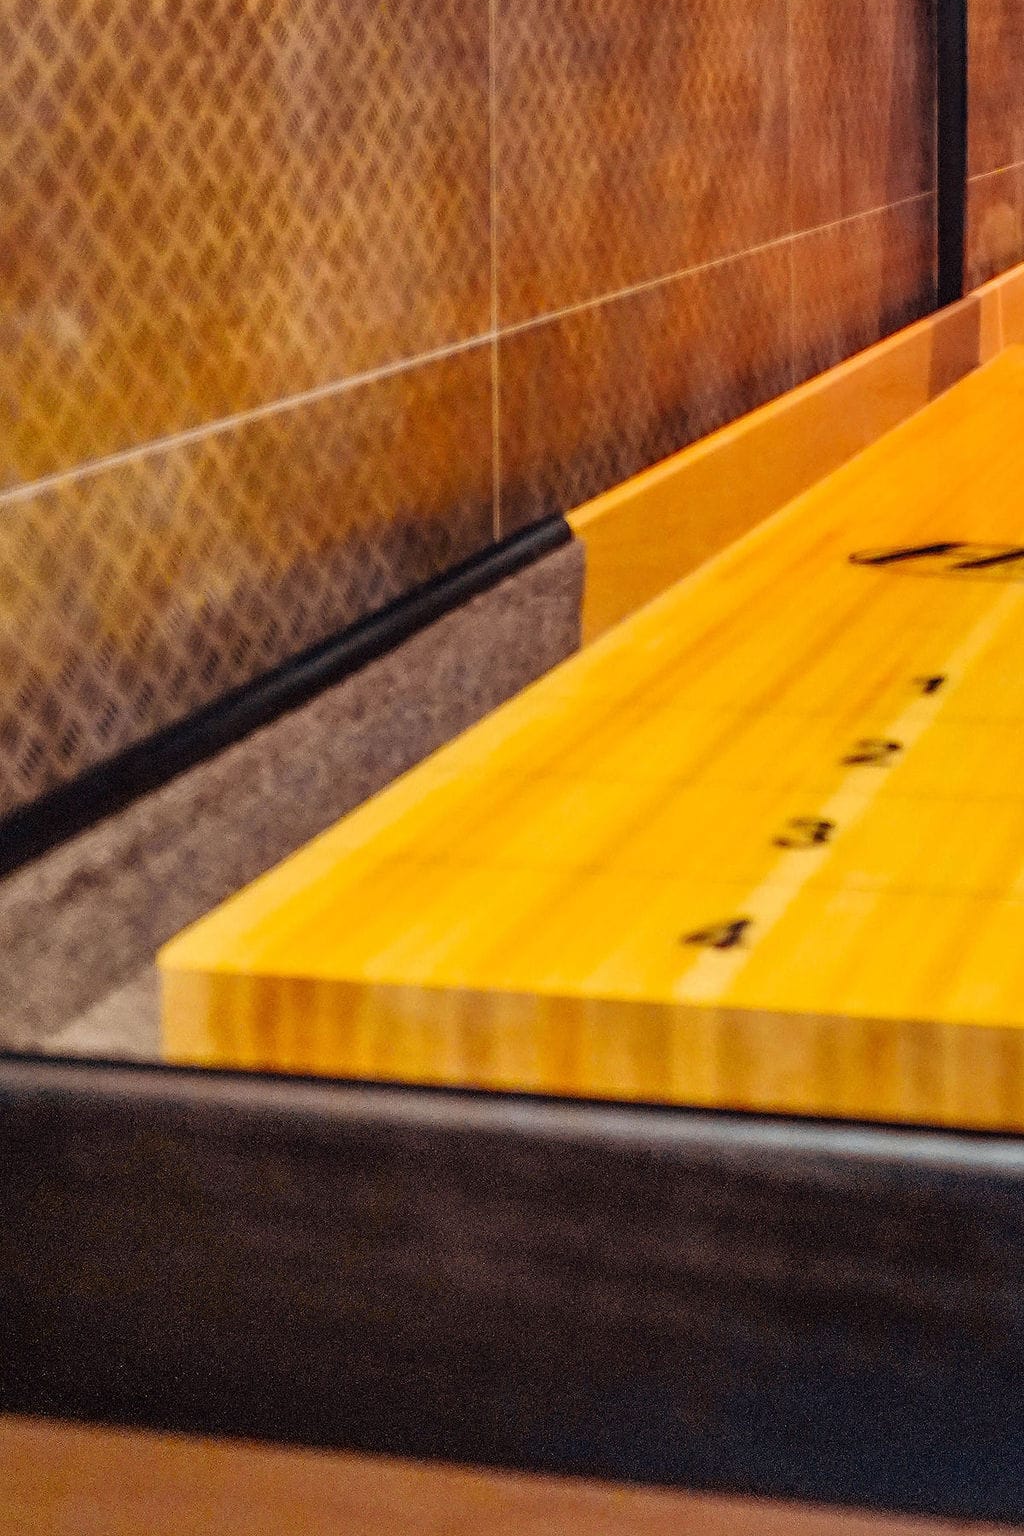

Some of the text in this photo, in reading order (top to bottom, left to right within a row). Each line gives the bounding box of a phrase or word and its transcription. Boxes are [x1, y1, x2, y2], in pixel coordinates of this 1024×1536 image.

[841, 737, 902, 766] 2
[771, 816, 836, 850] 3
[680, 918, 753, 951] 4
